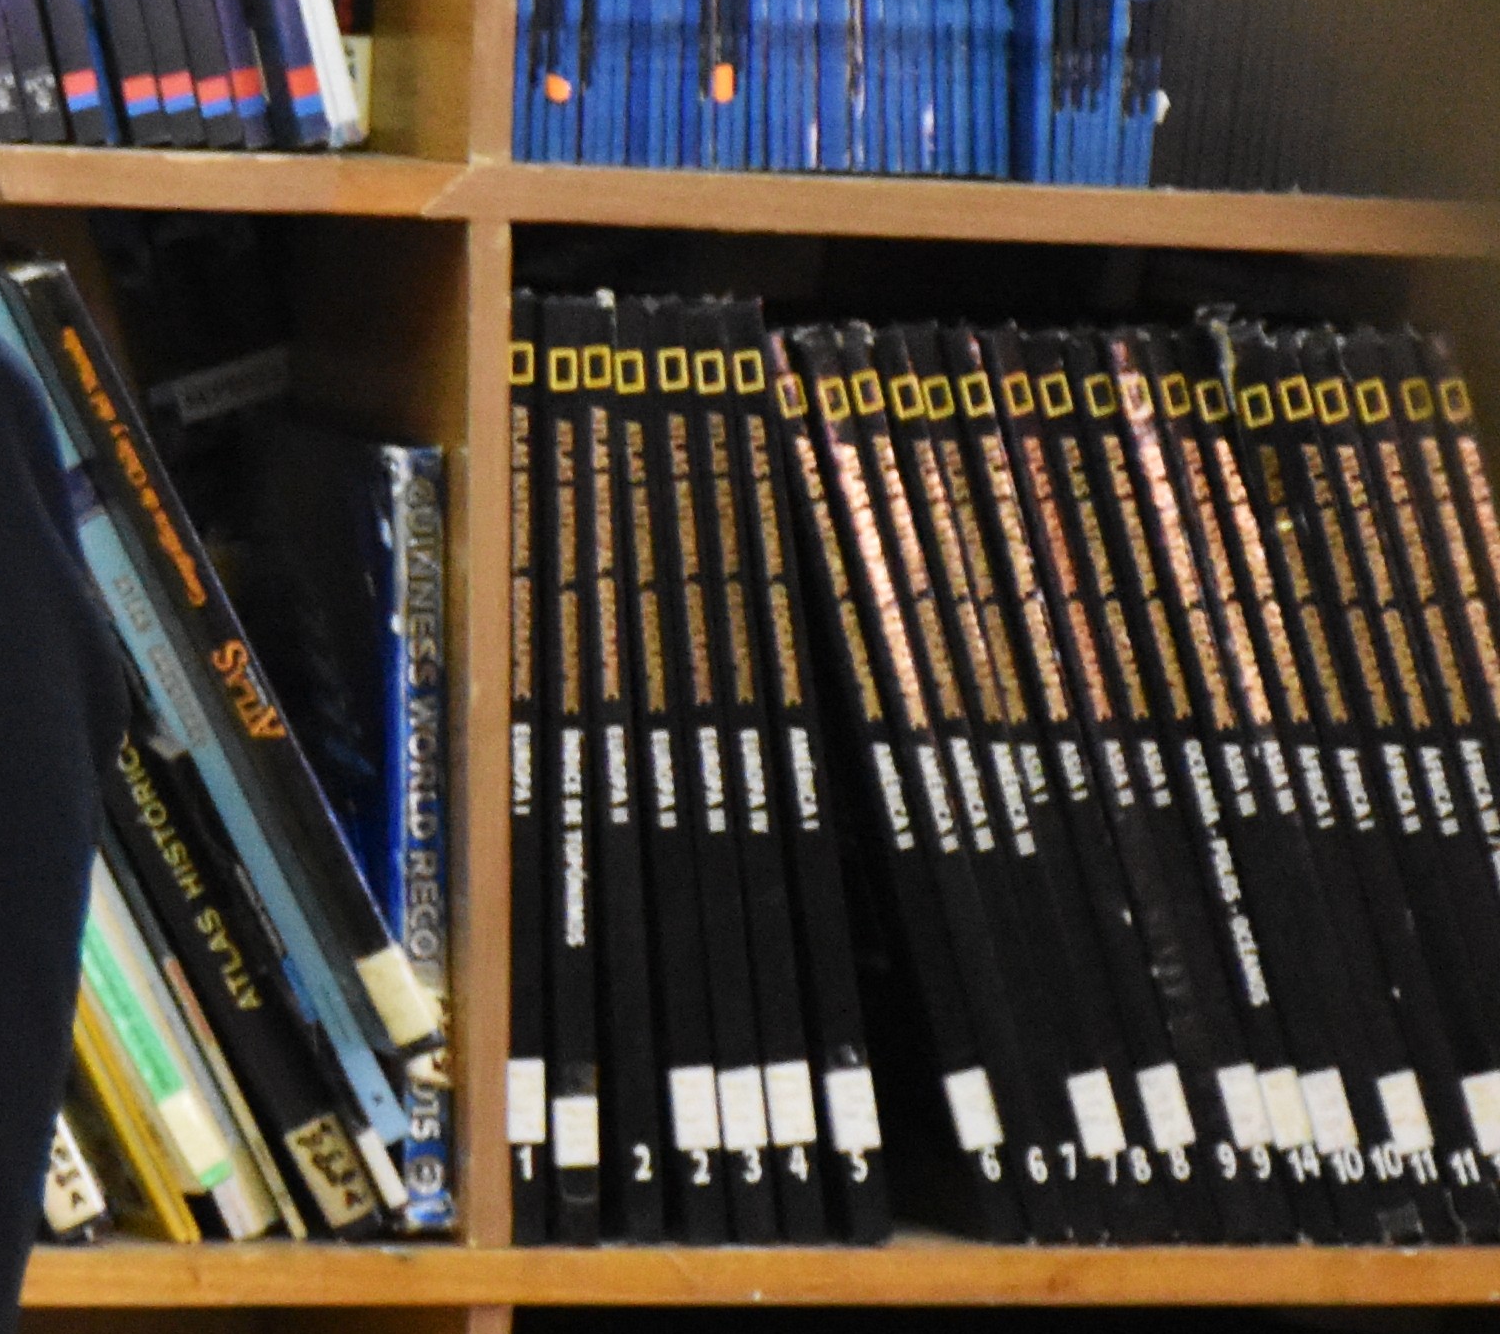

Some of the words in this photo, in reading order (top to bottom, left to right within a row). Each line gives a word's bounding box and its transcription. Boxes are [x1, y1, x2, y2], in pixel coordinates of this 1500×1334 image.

[404, 476, 440, 687] GUINNESS
[212, 638, 286, 741] ATLAS
[407, 695, 440, 838] WORLD
[512, 723, 532, 800] EUROPA
[1020, 743, 1046, 790] ASIA
[194, 906, 263, 1011] ATLAS
[520, 1147, 532, 1180] 1
[633, 1146, 652, 1181] 2
[744, 1149, 762, 1182] 3
[789, 1148, 808, 1181] 4
[850, 1151, 869, 1182] 5
[1028, 1148, 1048, 1183] 6
[1061, 1144, 1076, 1180] 7
[1130, 1148, 1151, 1183] 8
[1217, 1143, 1236, 1179] 9
[1331, 1149, 1364, 1184] 10
[1452, 1152, 1479, 1186] 11
